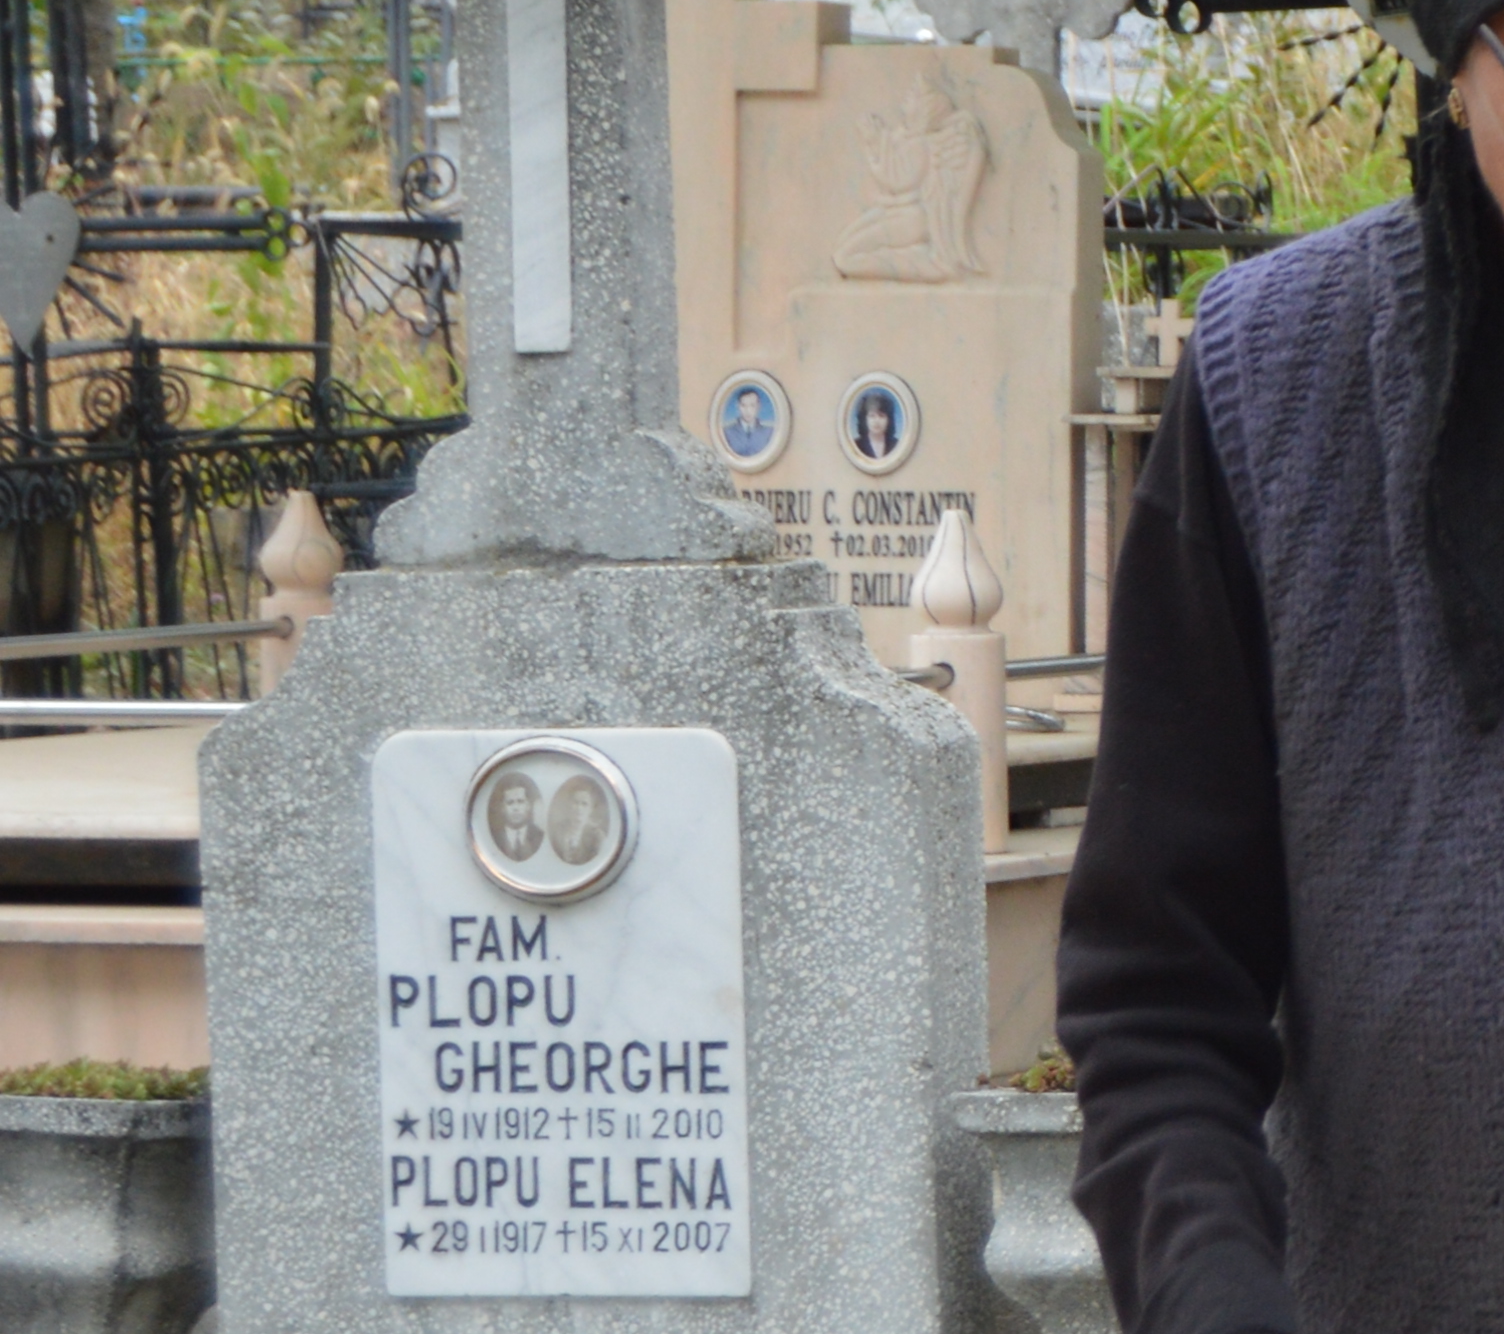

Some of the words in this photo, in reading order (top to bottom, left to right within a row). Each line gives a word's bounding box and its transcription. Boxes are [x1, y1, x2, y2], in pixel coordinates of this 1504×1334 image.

[822, 488, 842, 525] C.
[448, 915, 562, 963] FAM.
[389, 973, 577, 1028] PLOPU
[433, 1040, 731, 1094] GHEORGHE
[586, 1107, 616, 1139] 15
[651, 1107, 724, 1140] 2010
[390, 1156, 541, 1208] PLOPU
[567, 1157, 732, 1211] ELENA
[431, 1221, 469, 1254] 29
[582, 1221, 609, 1253] 15
[652, 1221, 732, 1254] 2007
